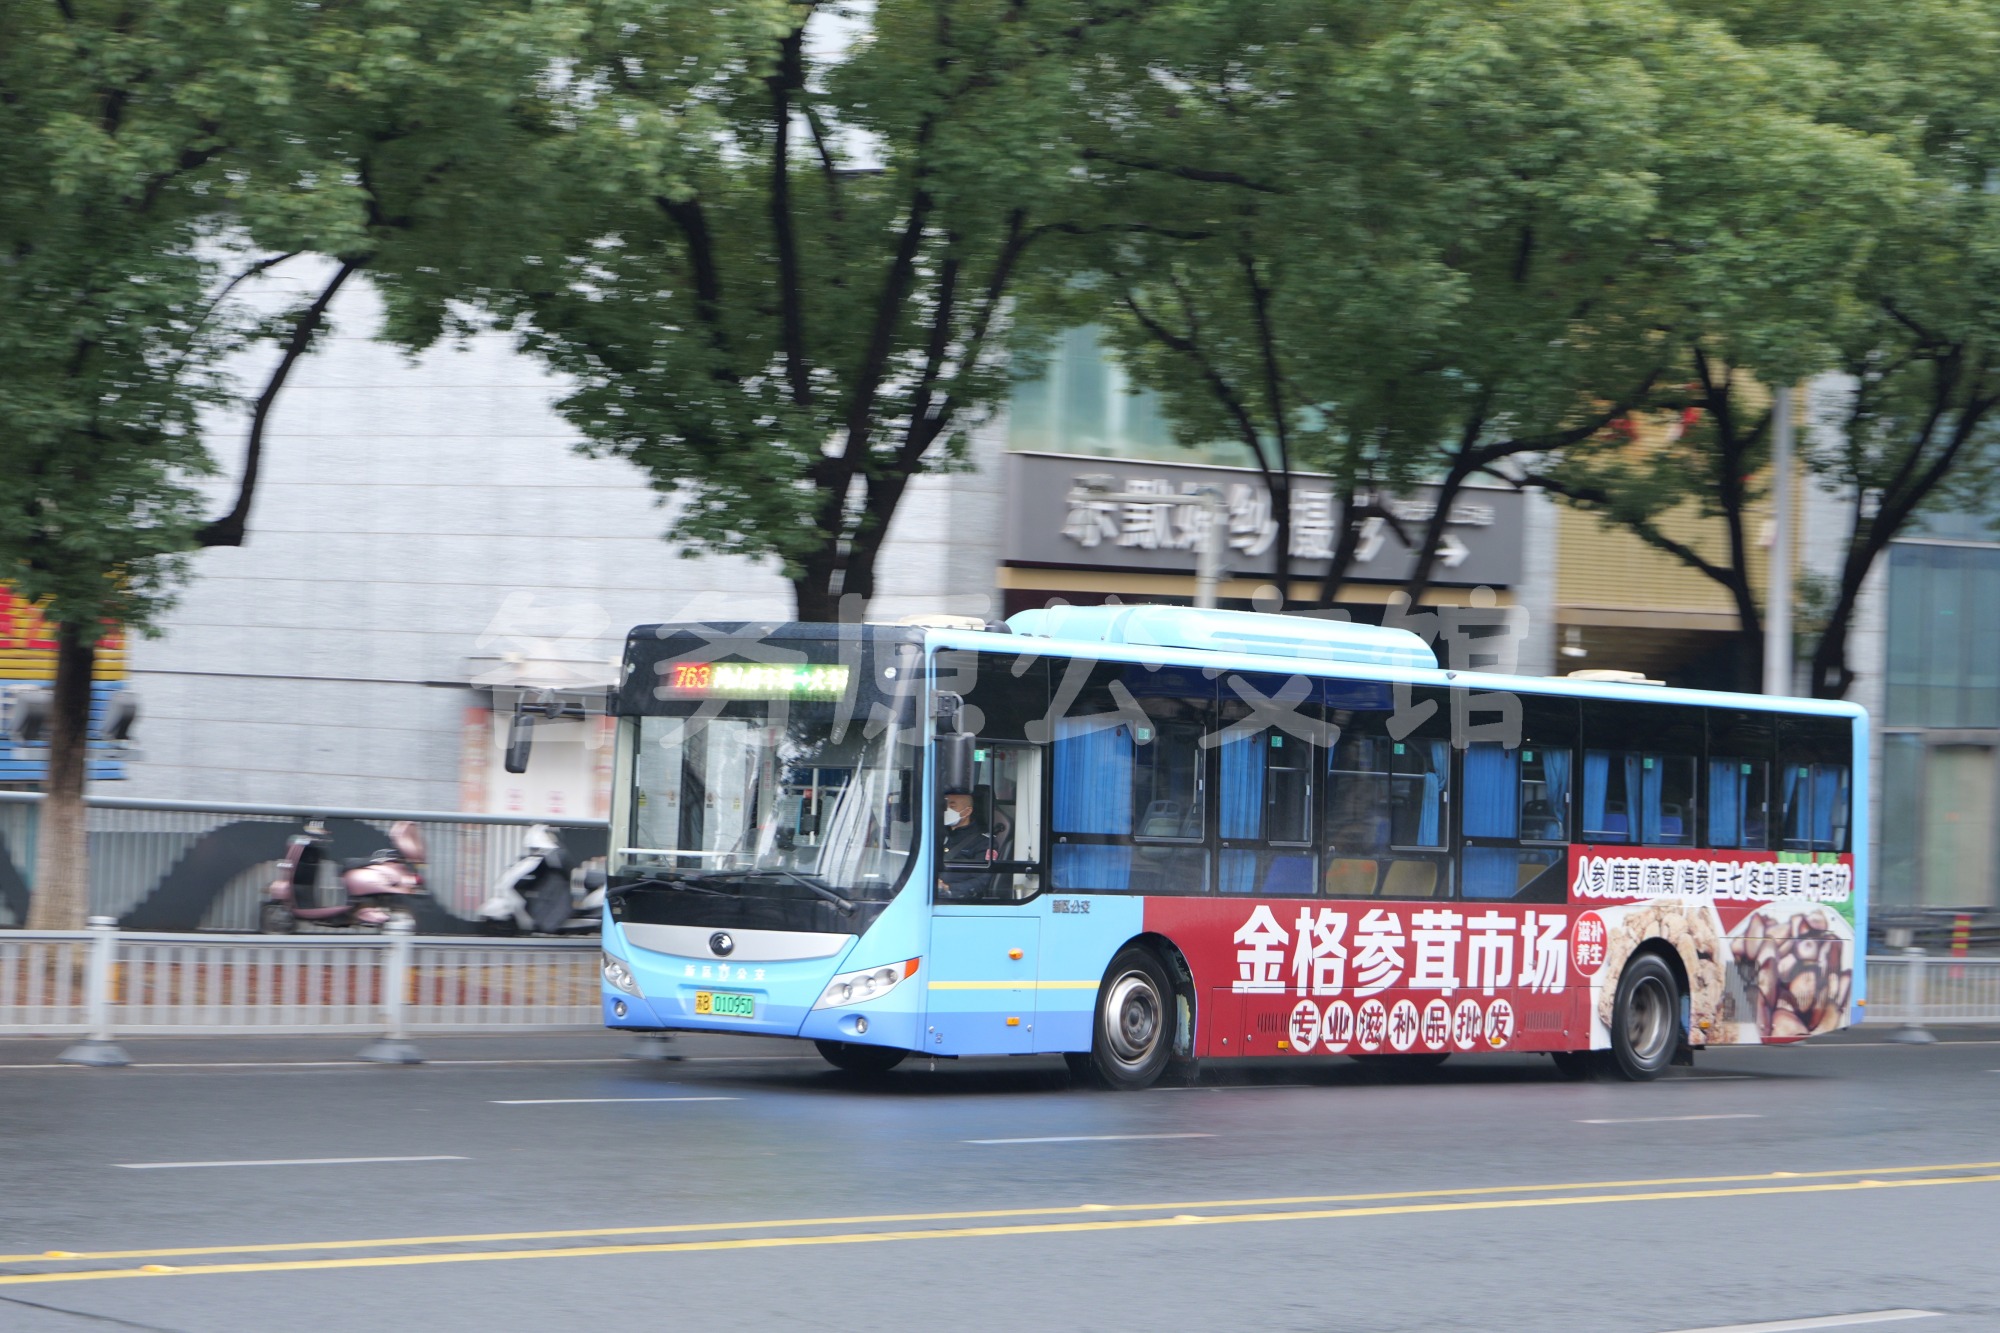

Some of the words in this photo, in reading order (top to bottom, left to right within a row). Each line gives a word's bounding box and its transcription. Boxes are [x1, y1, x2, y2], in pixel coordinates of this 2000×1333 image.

[675, 666, 711, 689] 763
[1577, 920, 1604, 942] 滋补
[1231, 904, 1569, 998] 金格参茸市场
[1577, 944, 1603, 966] 养生
[1291, 1003, 1512, 1047] 专业滋补品批发
